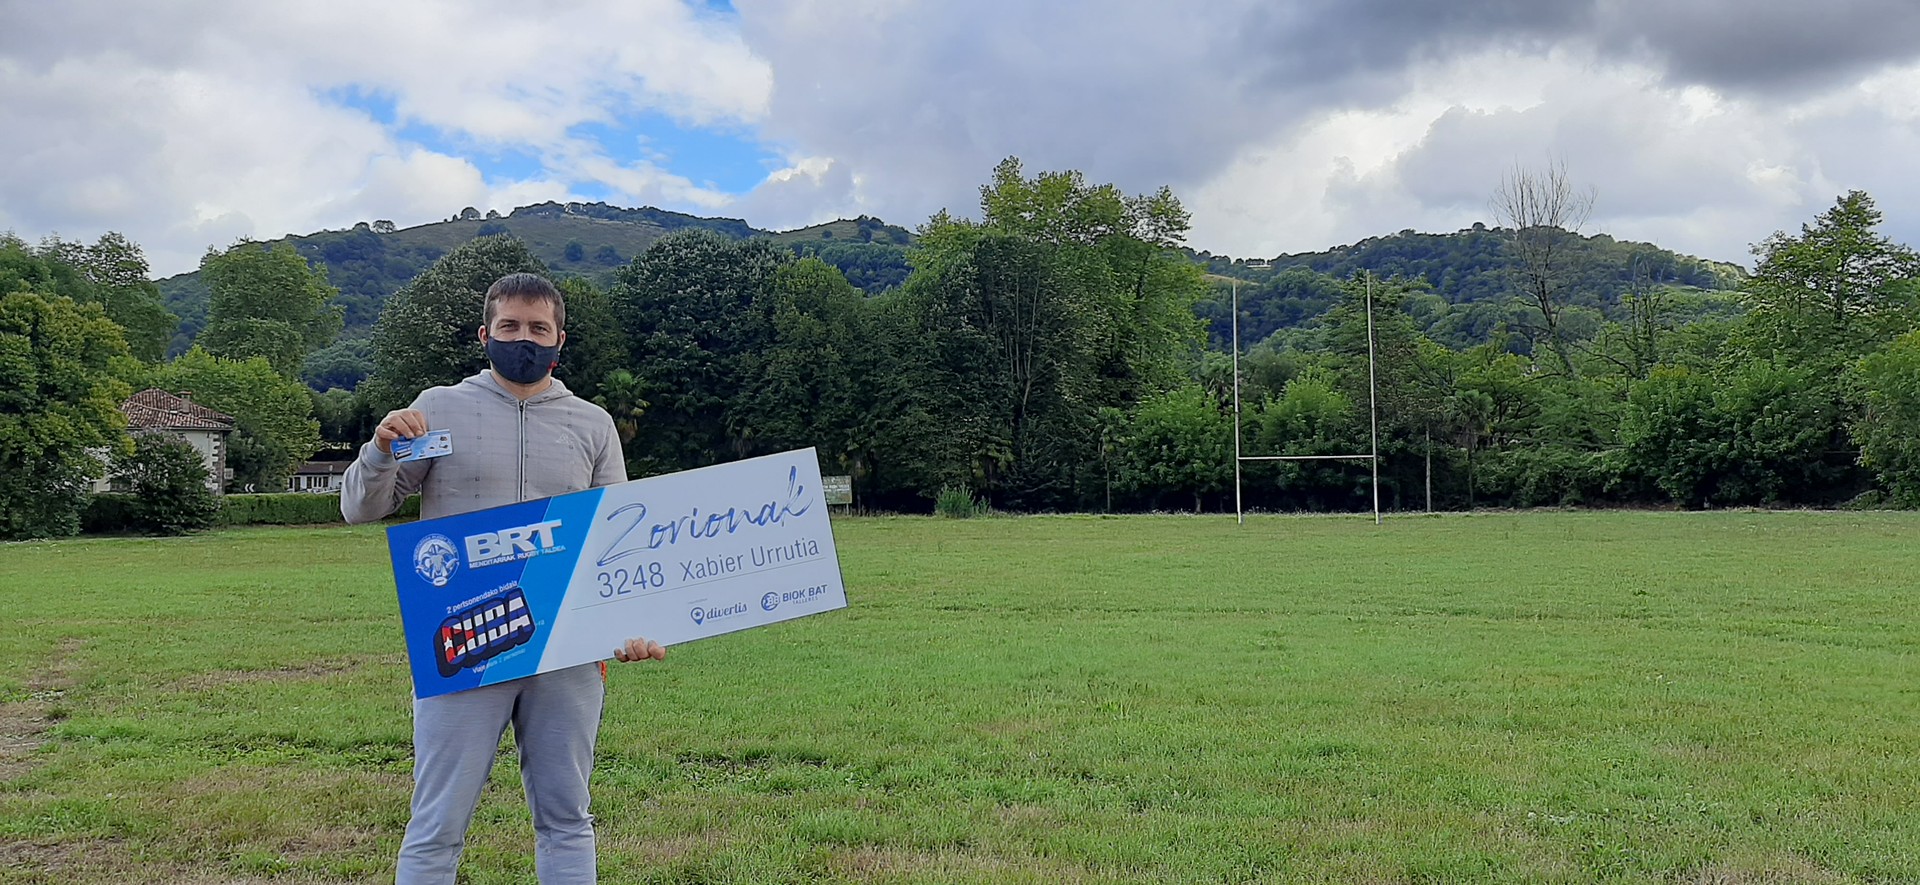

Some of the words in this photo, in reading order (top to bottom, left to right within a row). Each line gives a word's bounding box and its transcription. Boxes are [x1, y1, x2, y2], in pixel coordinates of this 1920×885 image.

[596, 466, 814, 566] Zorionak
[464, 519, 562, 562] BRT
[469, 555, 516, 569] MENDITARRAK
[517, 548, 540, 559] RUGBY
[541, 544, 566, 555] TALDEA
[597, 562, 665, 598] 3248
[679, 554, 744, 582] Xabier
[750, 537, 820, 567] Urrutia
[446, 606, 452, 614] 2
[782, 589, 806, 602] BIOK
[808, 584, 828, 597] BAT
[440, 589, 533, 666] CUBA
[706, 602, 748, 620] divertis
